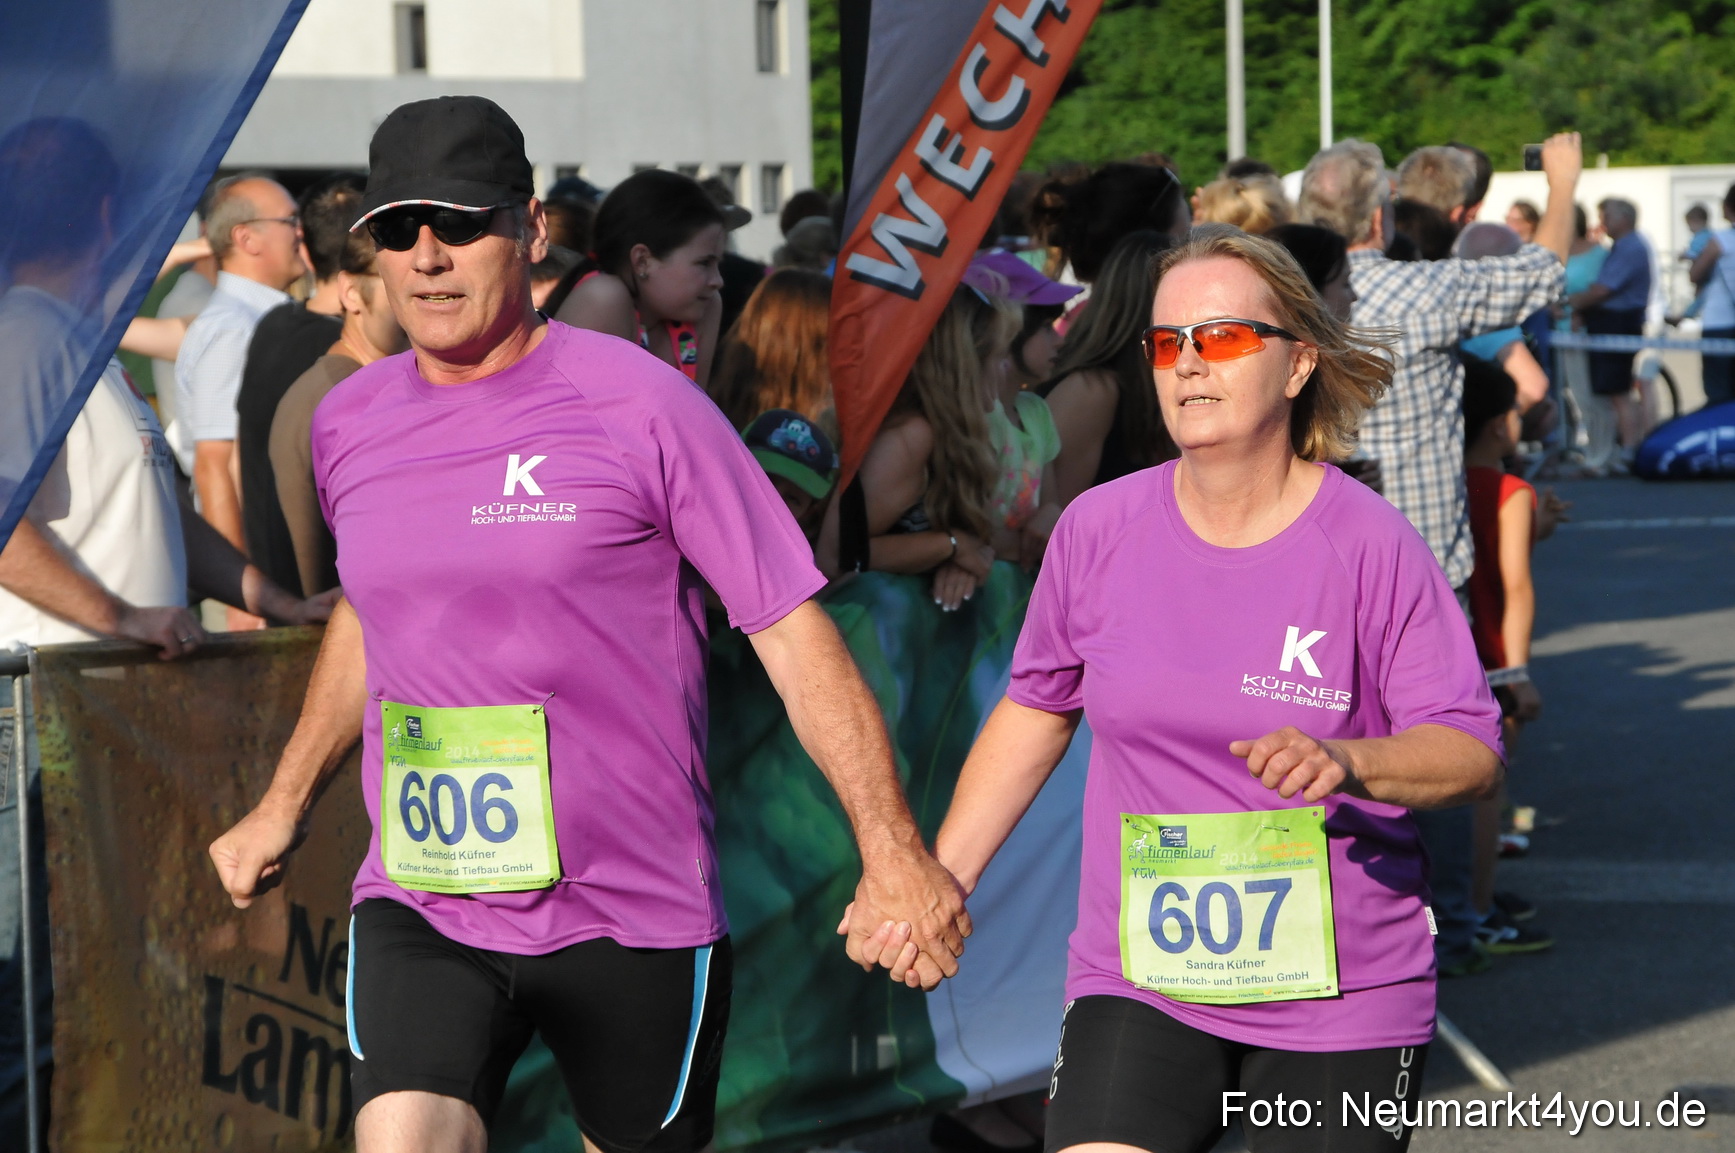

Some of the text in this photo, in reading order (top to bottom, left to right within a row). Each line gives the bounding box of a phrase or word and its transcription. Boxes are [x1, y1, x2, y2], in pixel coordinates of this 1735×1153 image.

[502, 454, 548, 496] K
[471, 502, 577, 516] KÜFNER
[470, 513, 576, 525] HOCH- UND TIEFBAU GMBH
[1279, 625, 1328, 679] K
[1242, 673, 1352, 703] KÜFNER
[1240, 685, 1351, 712] HOCH- UND TIEFBAU GMBH
[399, 734, 443, 751] firmenlauf
[445, 746, 480, 759] 2014
[399, 770, 519, 846] 606
[421, 848, 497, 861] Reinhold Küfner
[1148, 844, 1217, 859] firmenlauf
[1220, 852, 1258, 866] 2014
[397, 862, 533, 876] Küfner Hoch- und Tiefbau GmbH
[1148, 877, 1293, 955] 607
[1185, 959, 1266, 970] Sandra Küfner
[1146, 971, 1309, 986] Küfner Hoch- und Tiefbau GmbH
